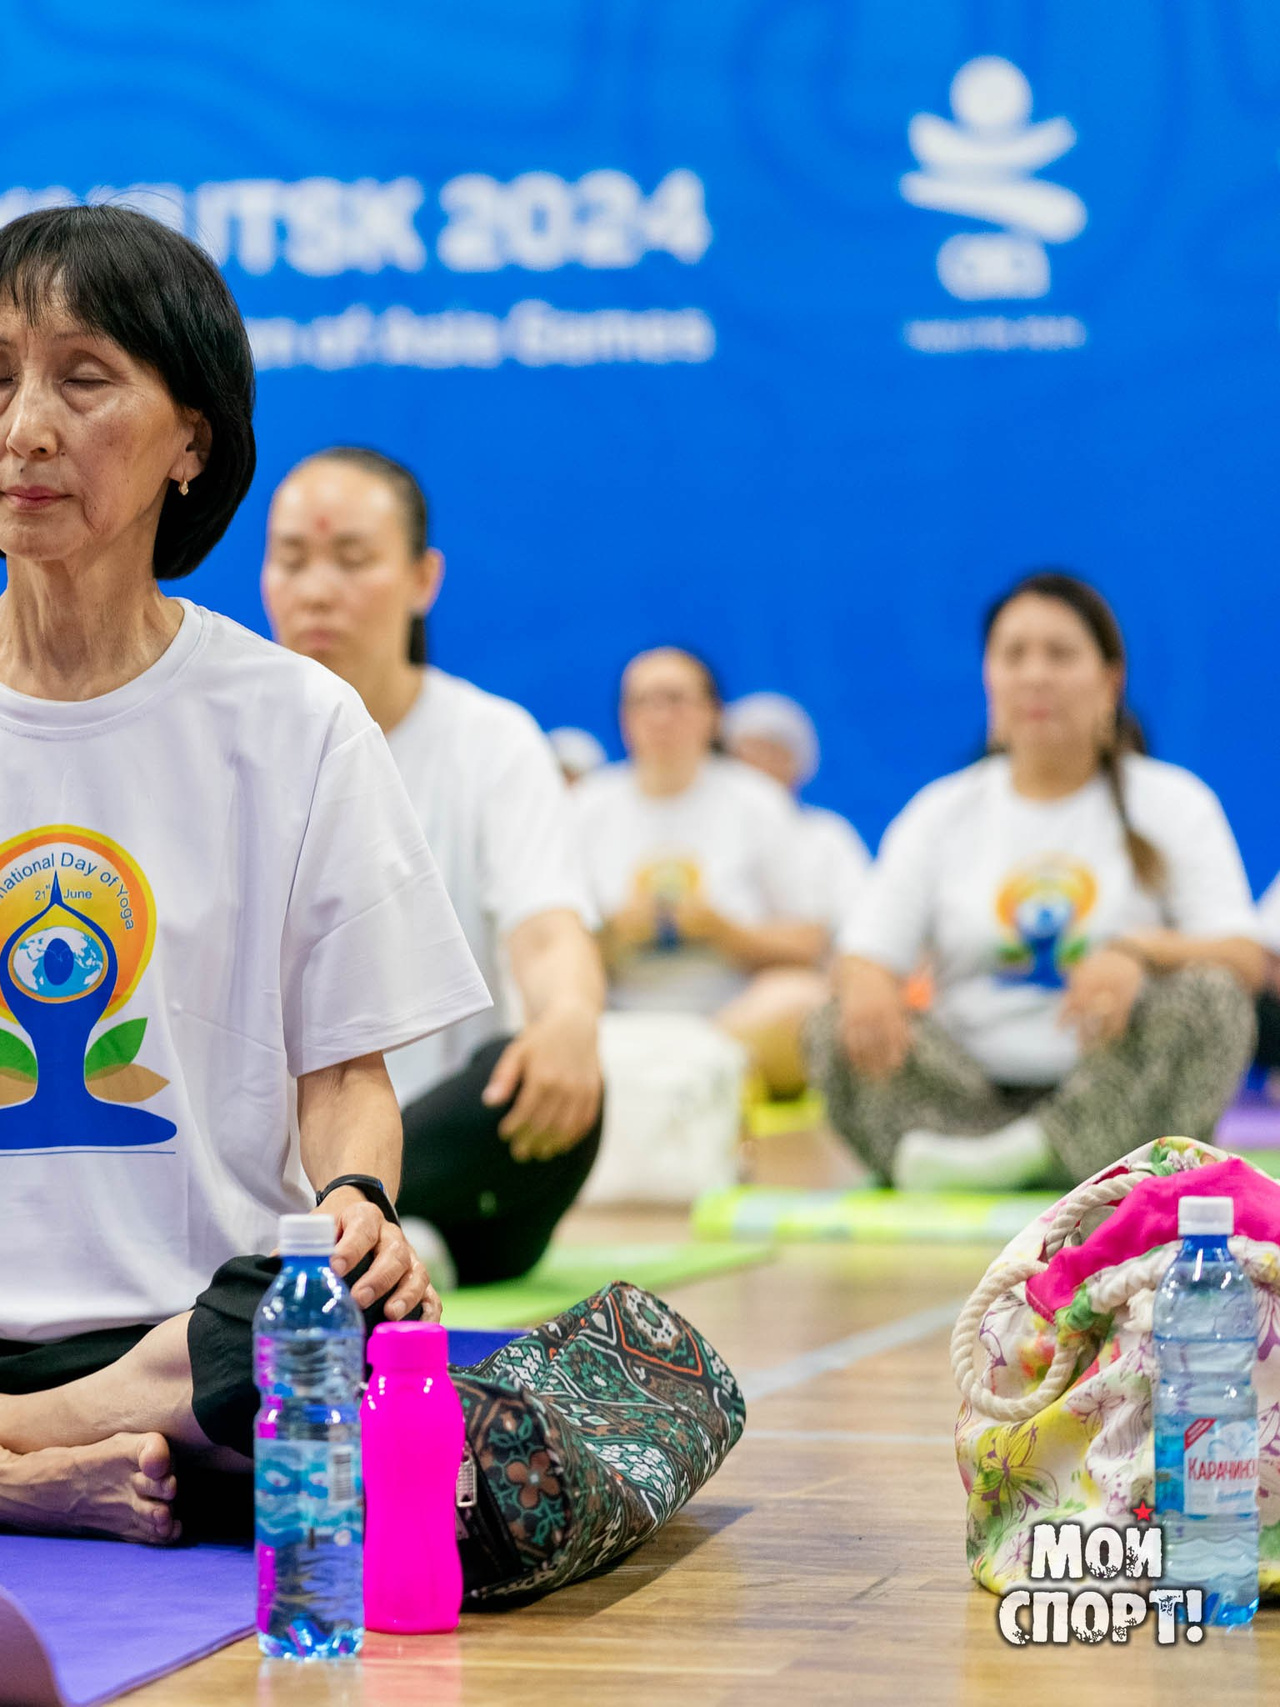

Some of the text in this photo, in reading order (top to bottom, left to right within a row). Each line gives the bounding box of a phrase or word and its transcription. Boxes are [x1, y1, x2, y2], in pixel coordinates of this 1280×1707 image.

[437, 169, 712, 272] 2024
[61, 852, 98, 876] Day
[100, 871, 119, 887] of
[117, 884, 135, 930] Yoga
[64, 888, 92, 899] June
